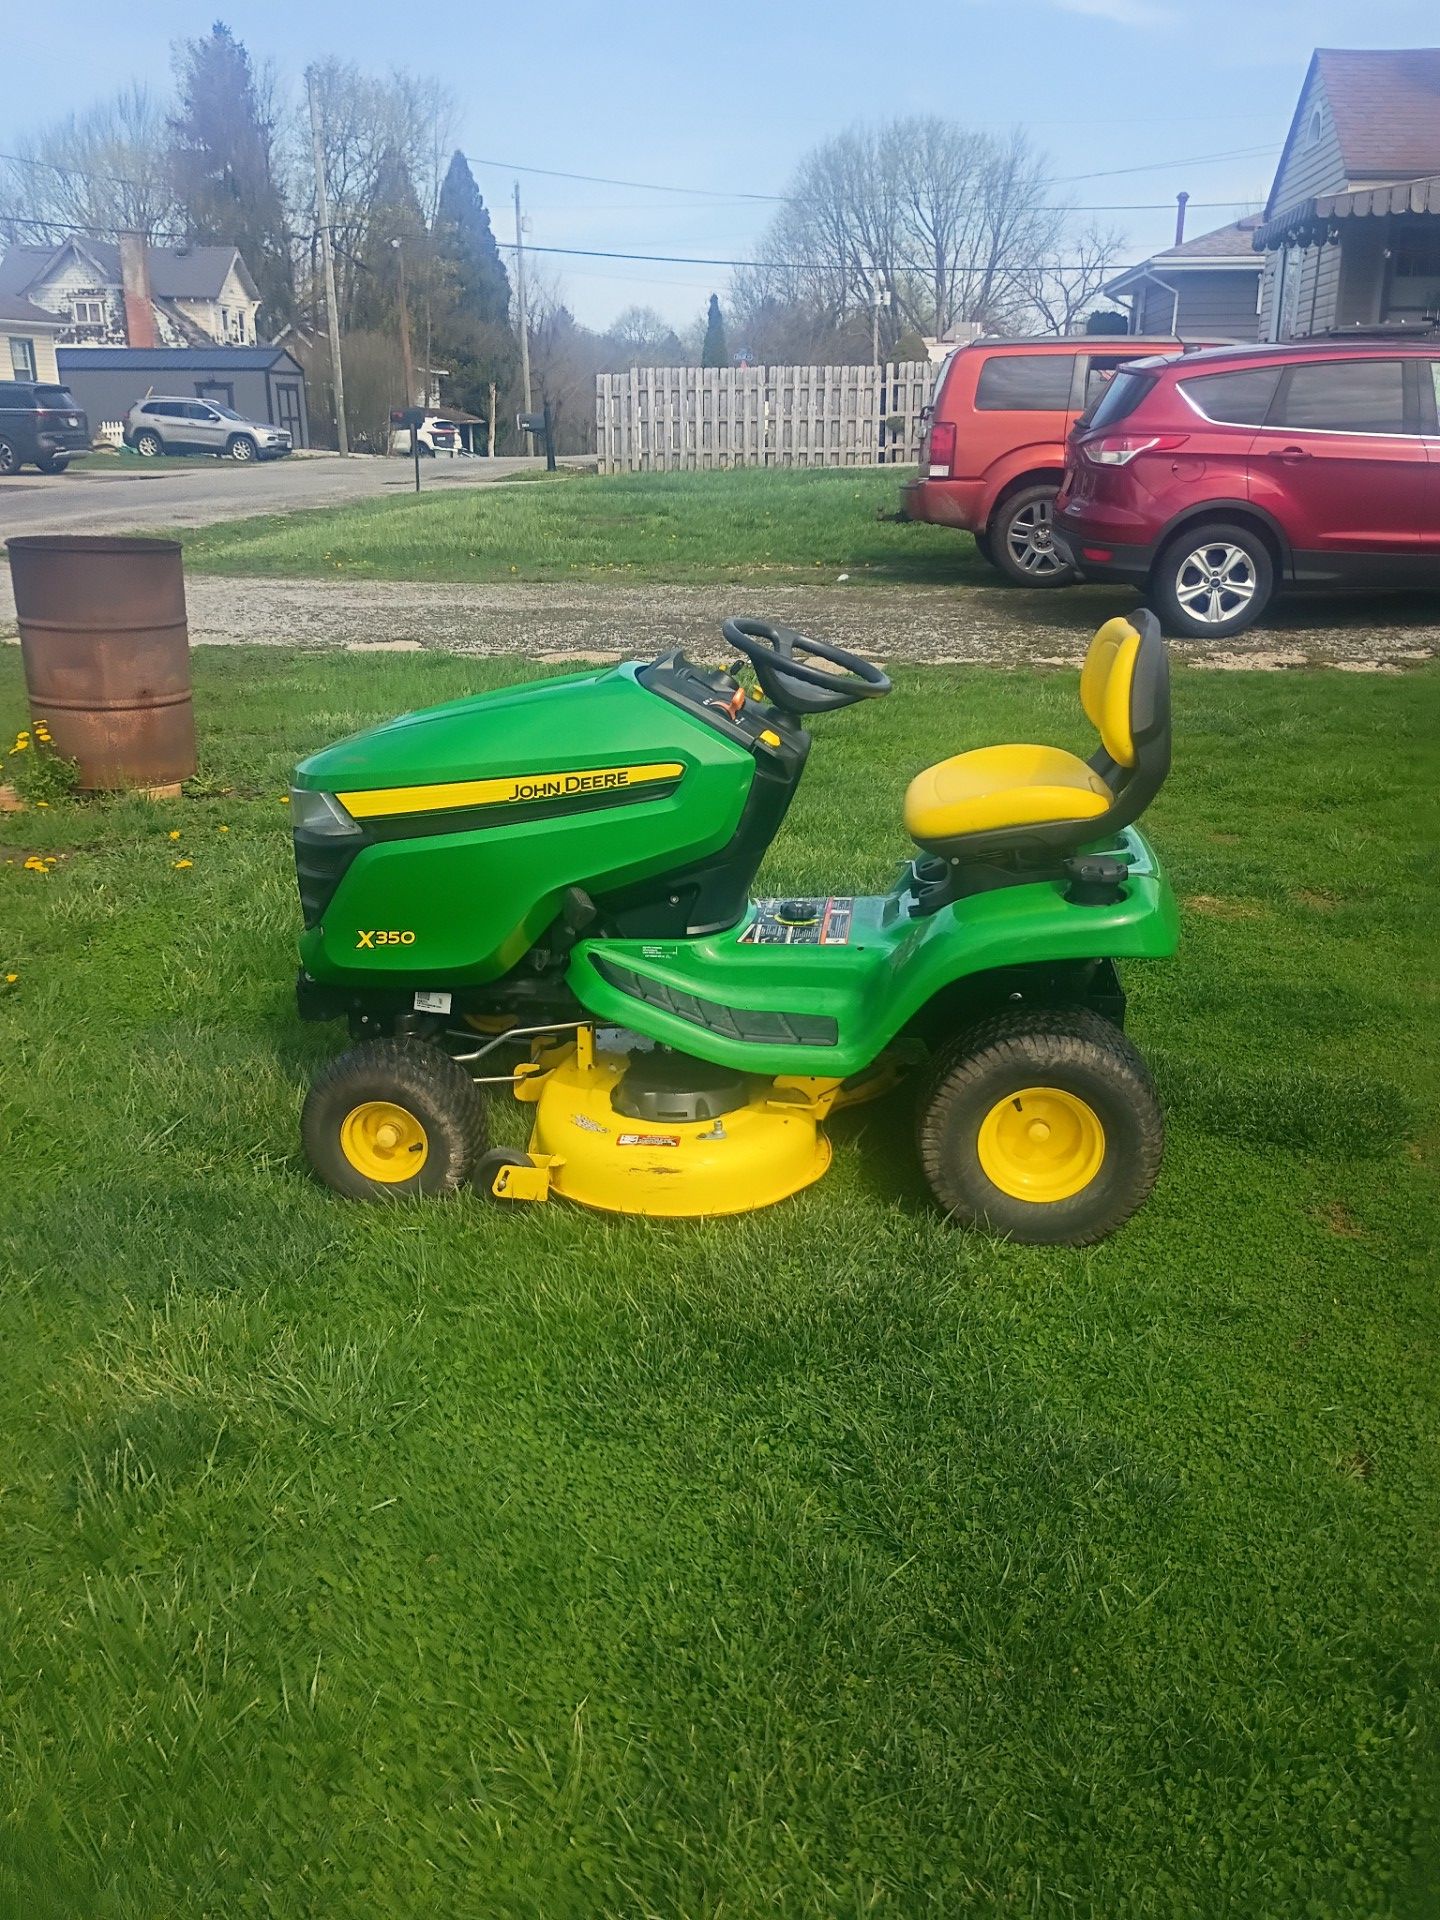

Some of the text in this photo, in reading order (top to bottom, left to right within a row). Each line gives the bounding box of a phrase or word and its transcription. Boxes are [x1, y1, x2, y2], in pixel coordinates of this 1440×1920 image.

[508, 771, 629, 800] JOHN DEERE
[355, 930, 416, 949] X350
